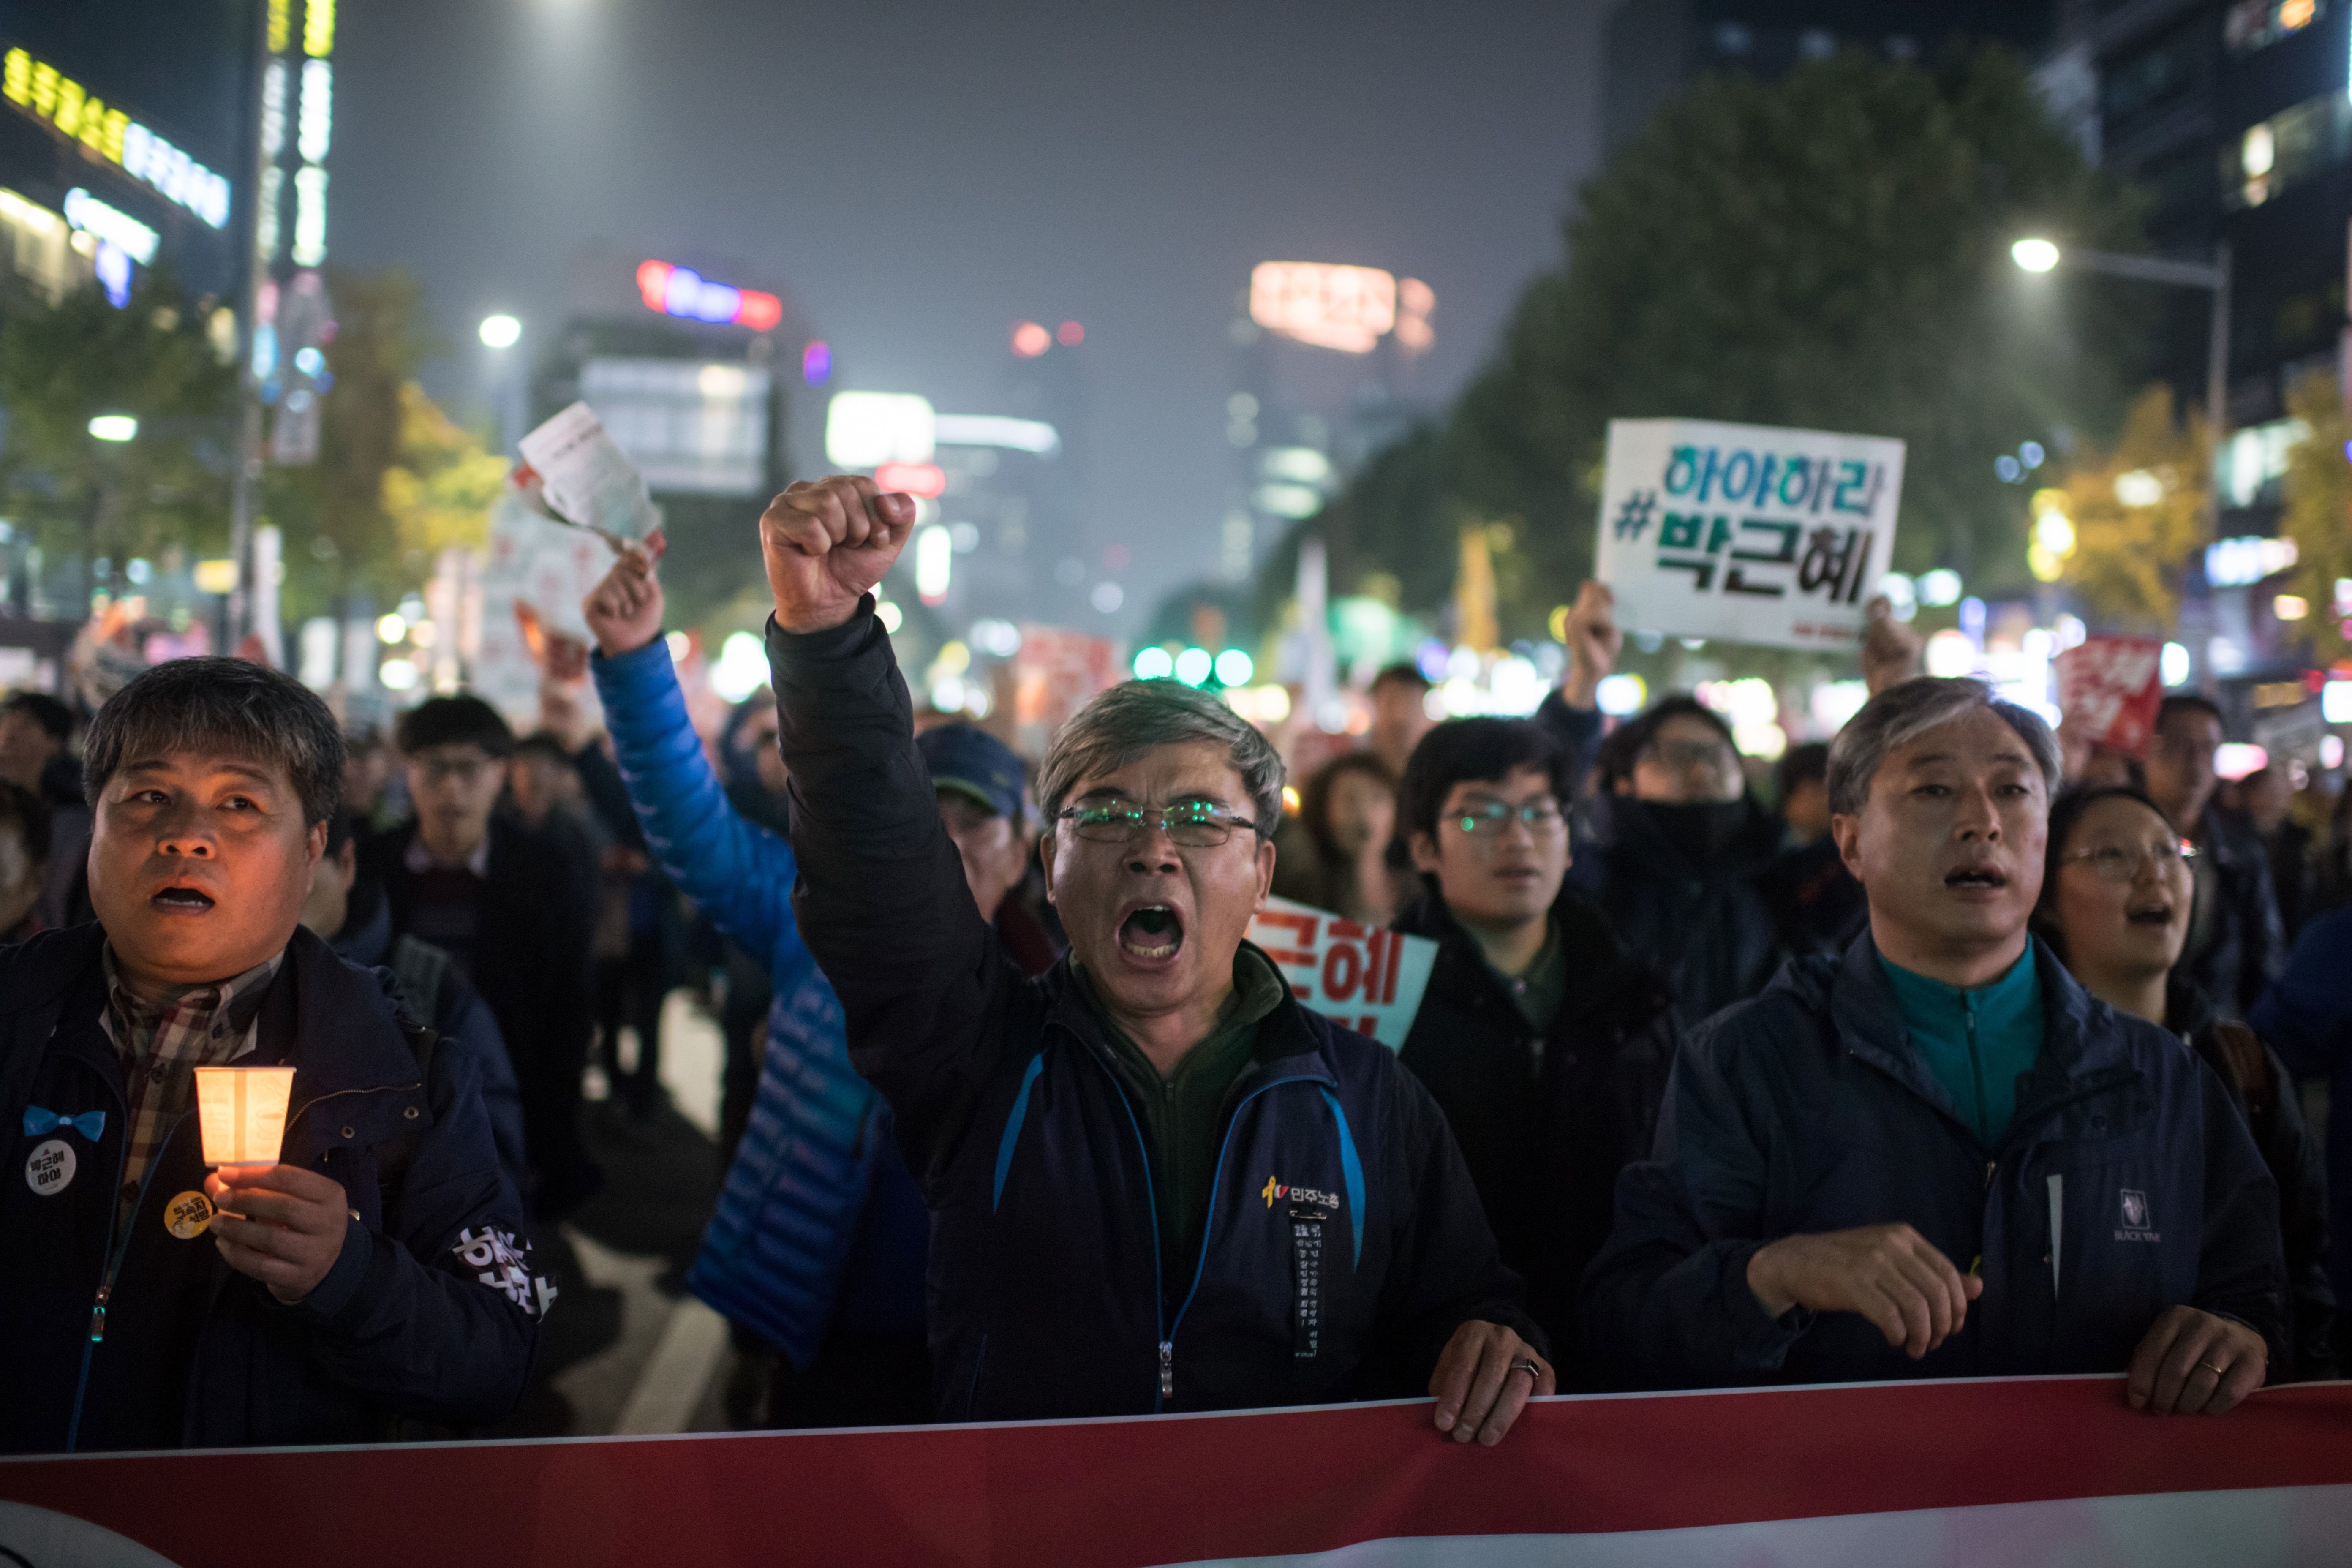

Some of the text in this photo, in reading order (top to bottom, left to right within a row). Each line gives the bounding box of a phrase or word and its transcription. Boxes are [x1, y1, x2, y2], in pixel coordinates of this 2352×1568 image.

[1666, 444, 1885, 517] 하야하라
[1243, 910, 1403, 1005] 근혜
[31, 1150, 64, 1171] 박근혜
[38, 1168, 61, 1185] 하야
[1290, 1187, 1339, 1209] 민주노총
